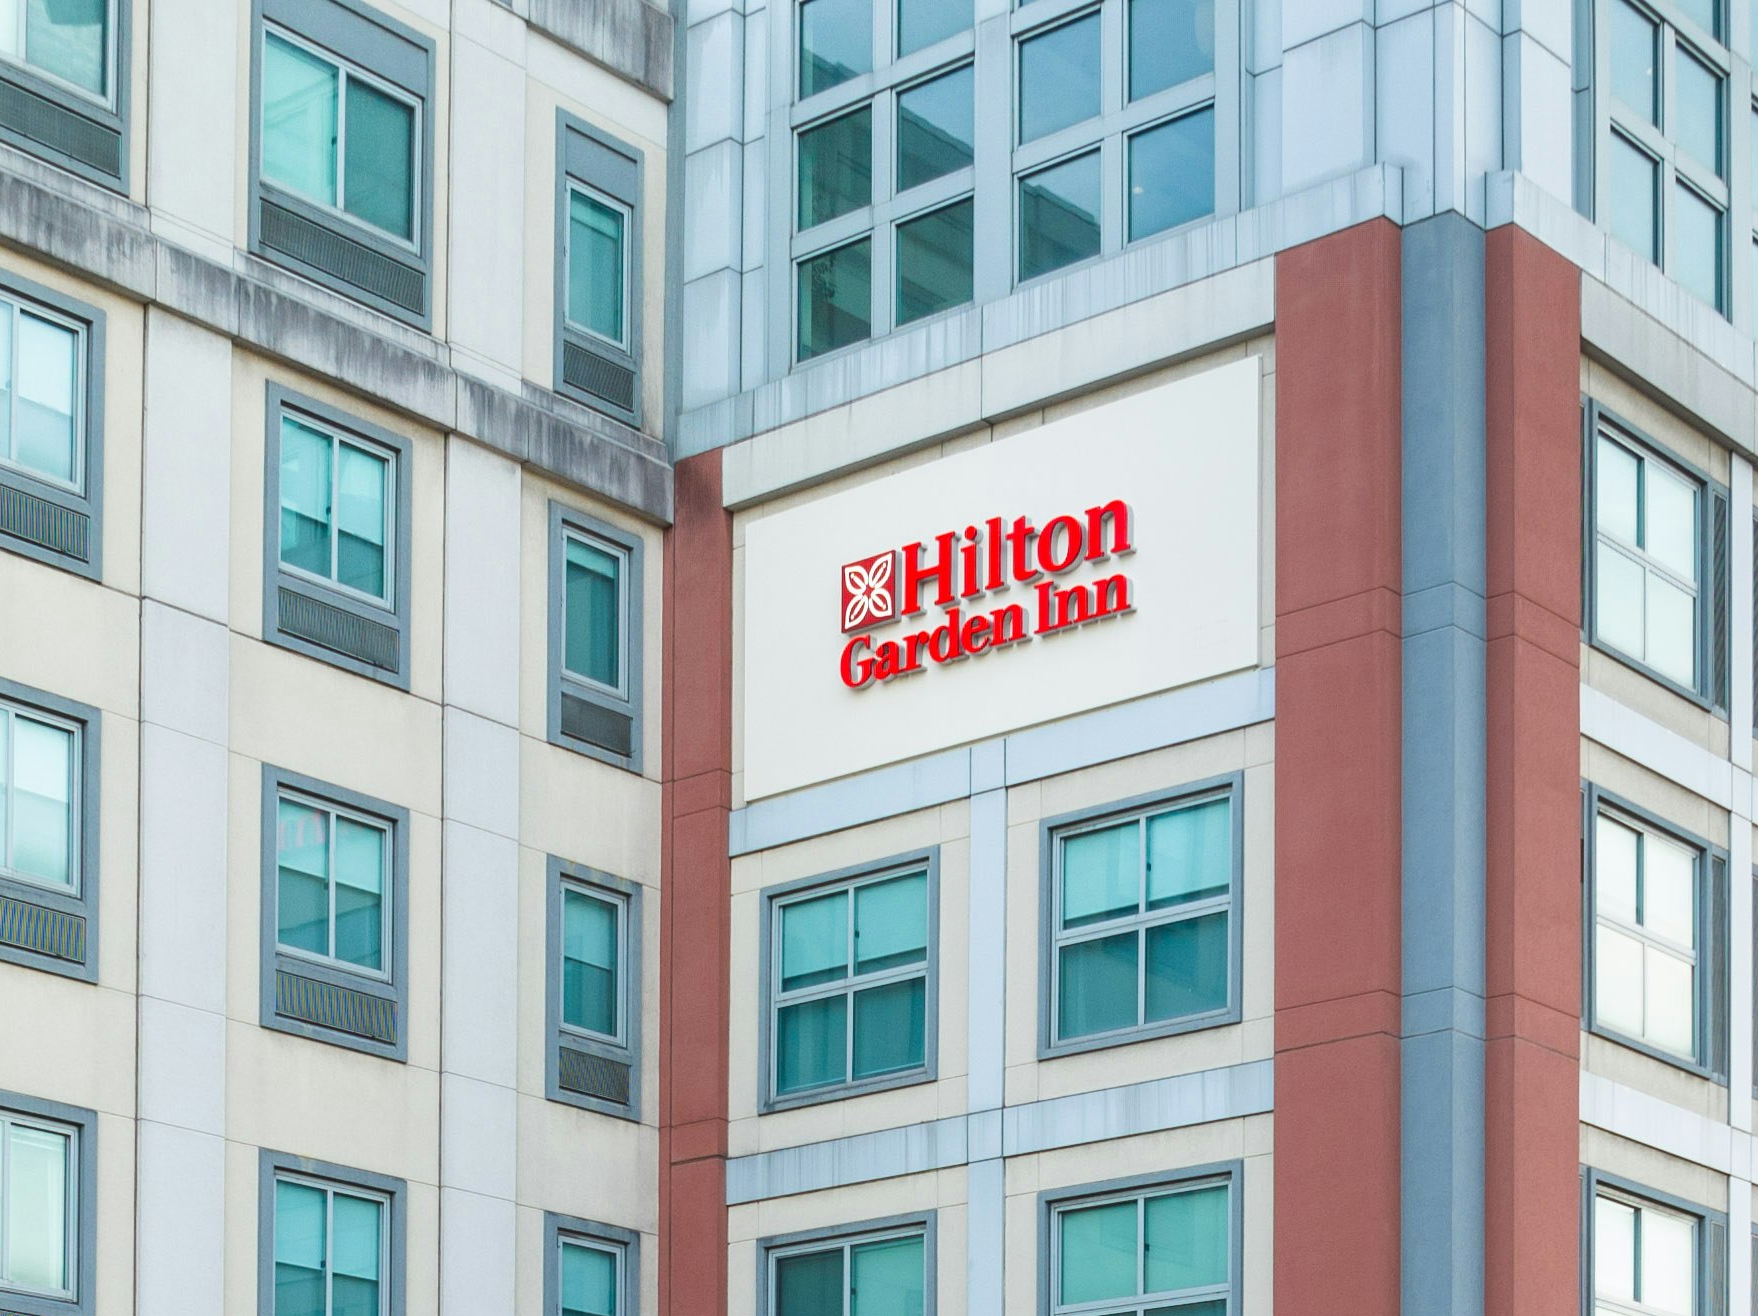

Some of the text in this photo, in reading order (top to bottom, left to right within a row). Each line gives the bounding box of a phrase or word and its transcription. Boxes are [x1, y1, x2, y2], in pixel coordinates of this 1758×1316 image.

[901, 499, 1135, 617] Hilton
[840, 573, 1134, 689] Garden Inn
